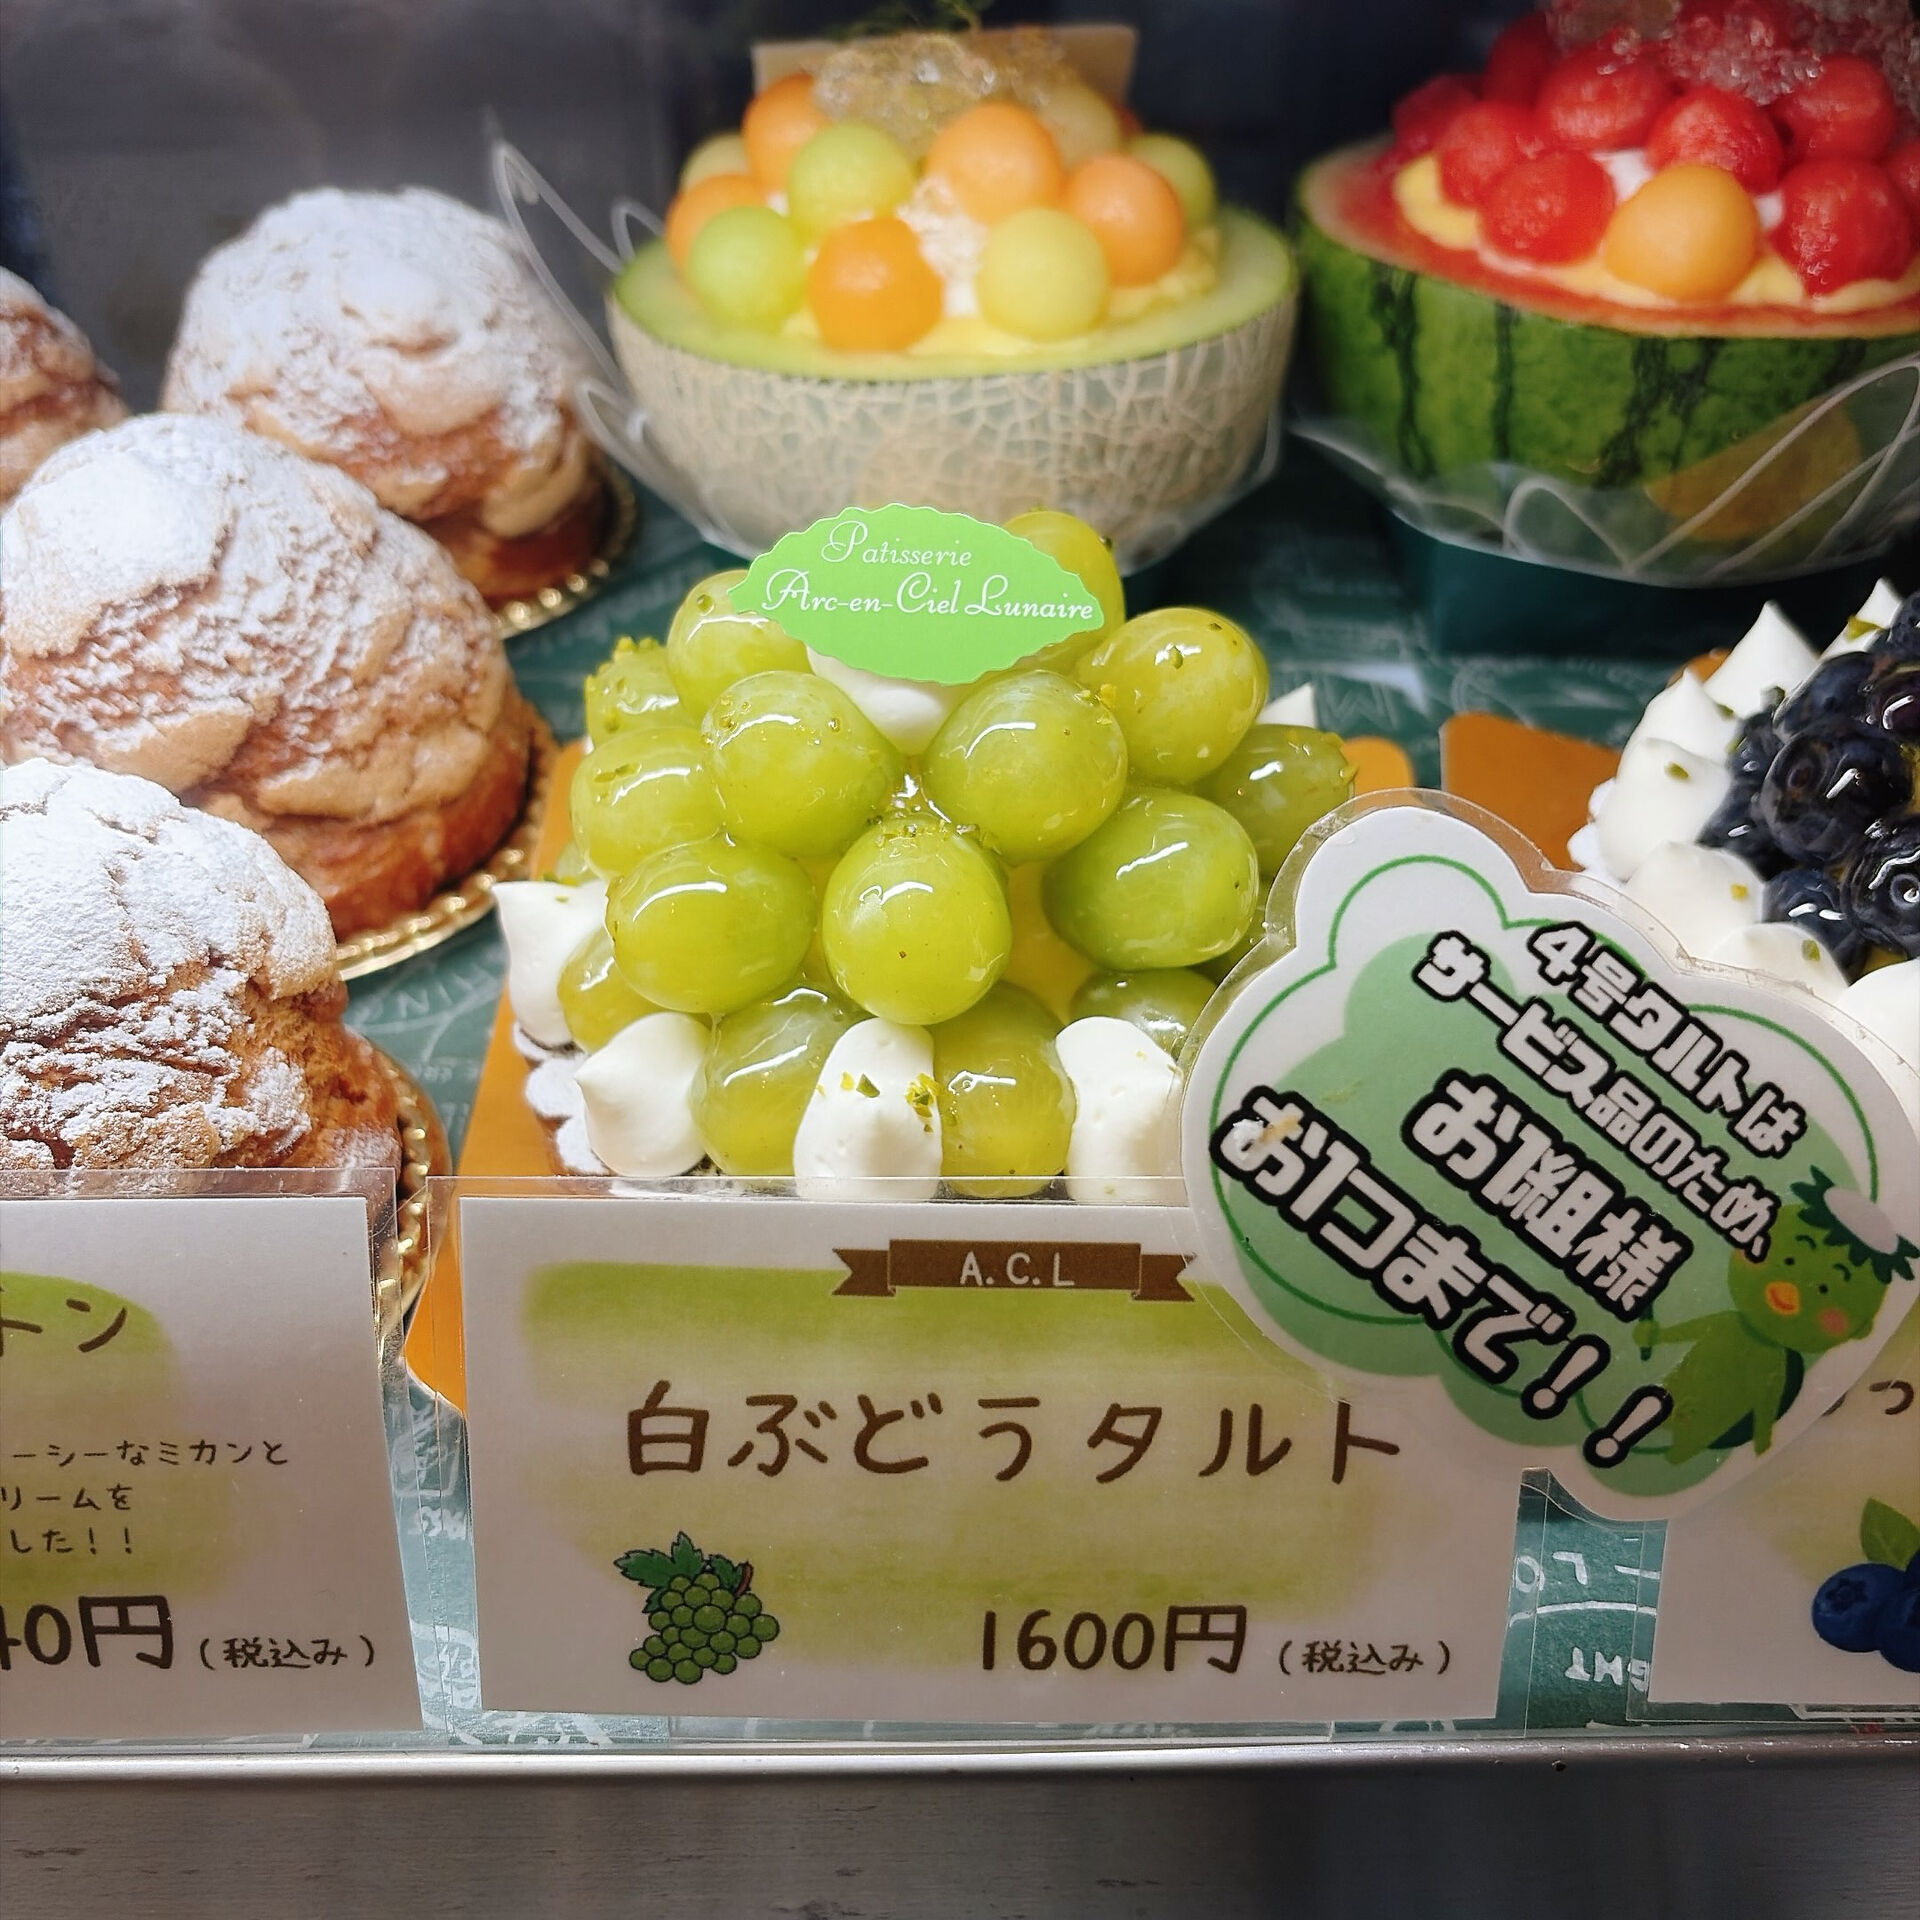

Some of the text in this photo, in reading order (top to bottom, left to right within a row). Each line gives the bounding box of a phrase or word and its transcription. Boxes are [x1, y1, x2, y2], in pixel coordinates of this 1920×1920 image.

[821, 520, 971, 567] Patisserie
[762, 569, 1093, 620] Arc-en-Ciel Lunaire
[1530, 920, 1806, 1157] 4号タルトは
[1412, 932, 1781, 1262] サービス品のため、
[1401, 1069, 1693, 1320] お1組様
[12, 1439, 288, 1468] ーシーなミカンと
[627, 1380, 1400, 1485] 白ぶどうタルト
[981, 1605, 1248, 1674] 1600円
